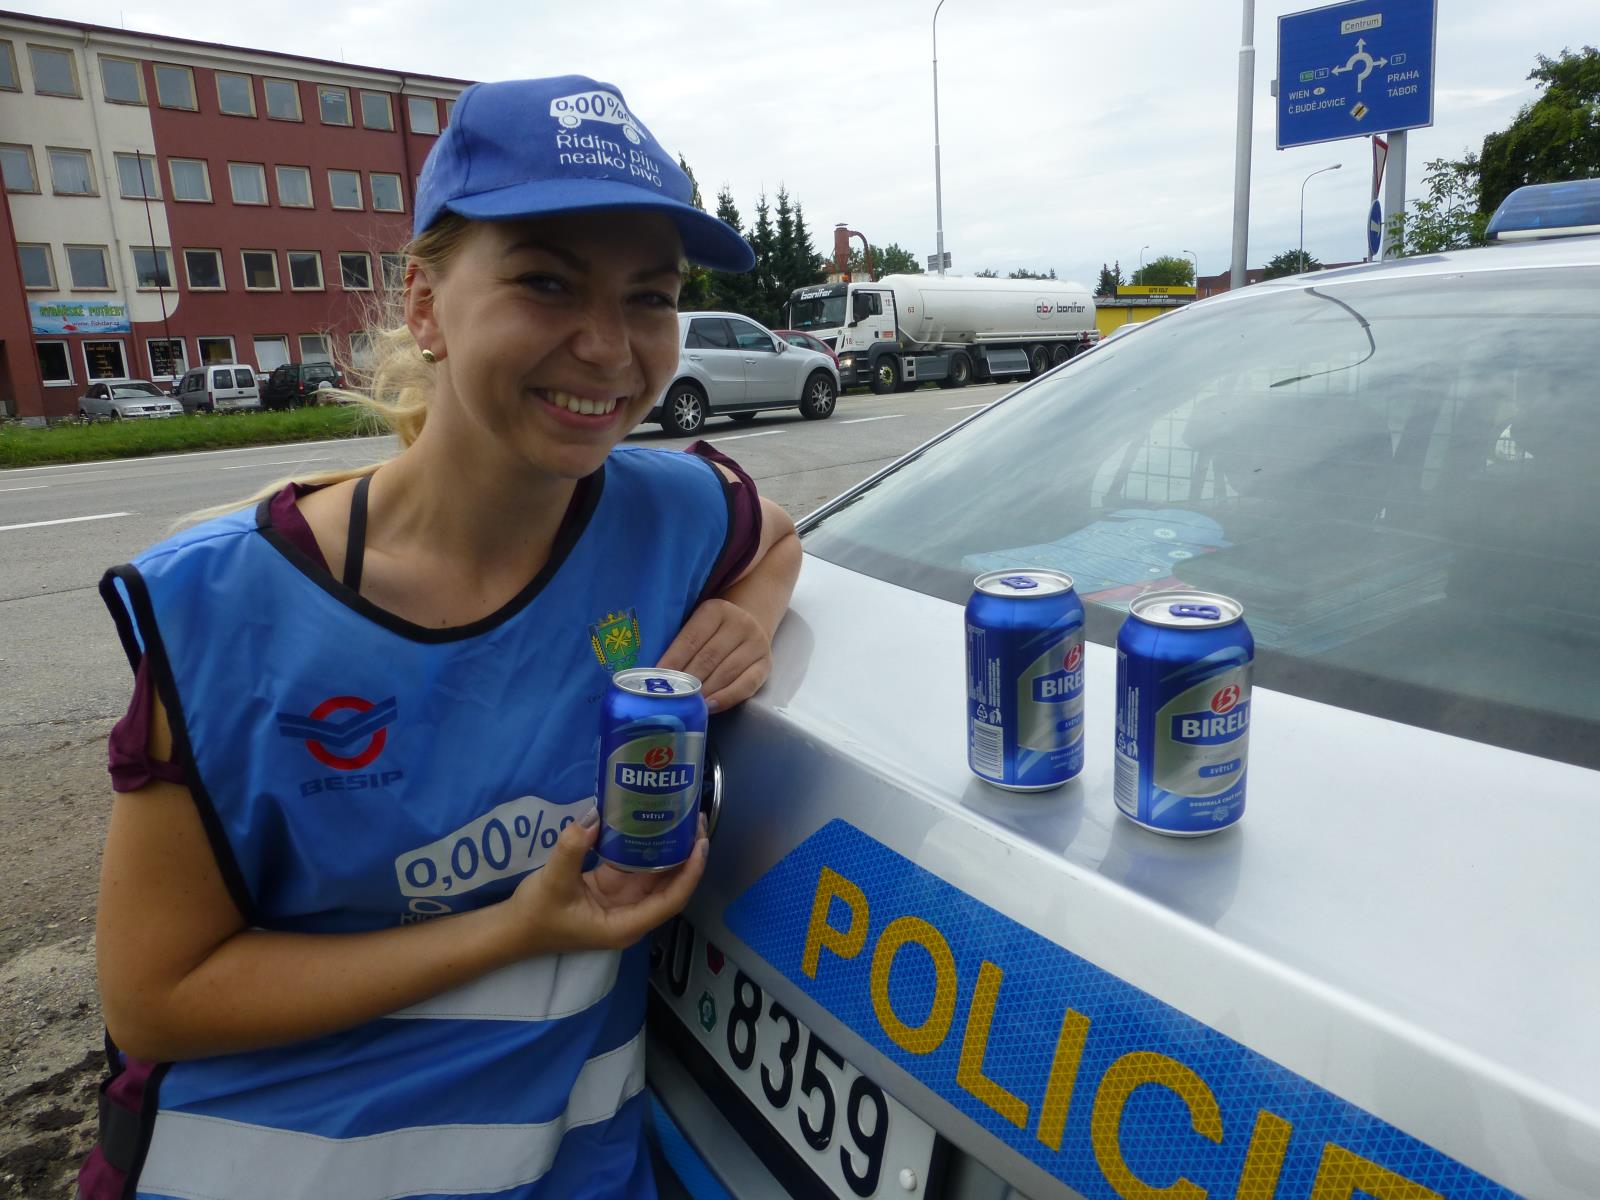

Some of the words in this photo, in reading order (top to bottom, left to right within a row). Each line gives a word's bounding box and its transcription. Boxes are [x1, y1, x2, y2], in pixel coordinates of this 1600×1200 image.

[1344, 18, 1379, 31] Centrum
[1387, 70, 1419, 83] PRAHA
[1288, 89, 1310, 100] WIEN
[560, 150, 625, 169] nealko
[629, 164, 662, 188] pivo
[629, 149, 660, 174] piju
[1042, 671, 1084, 697] BIRE
[300, 770, 404, 798] BESIP
[621, 767, 689, 788] BIRELL
[727, 968, 889, 1198] 8359
